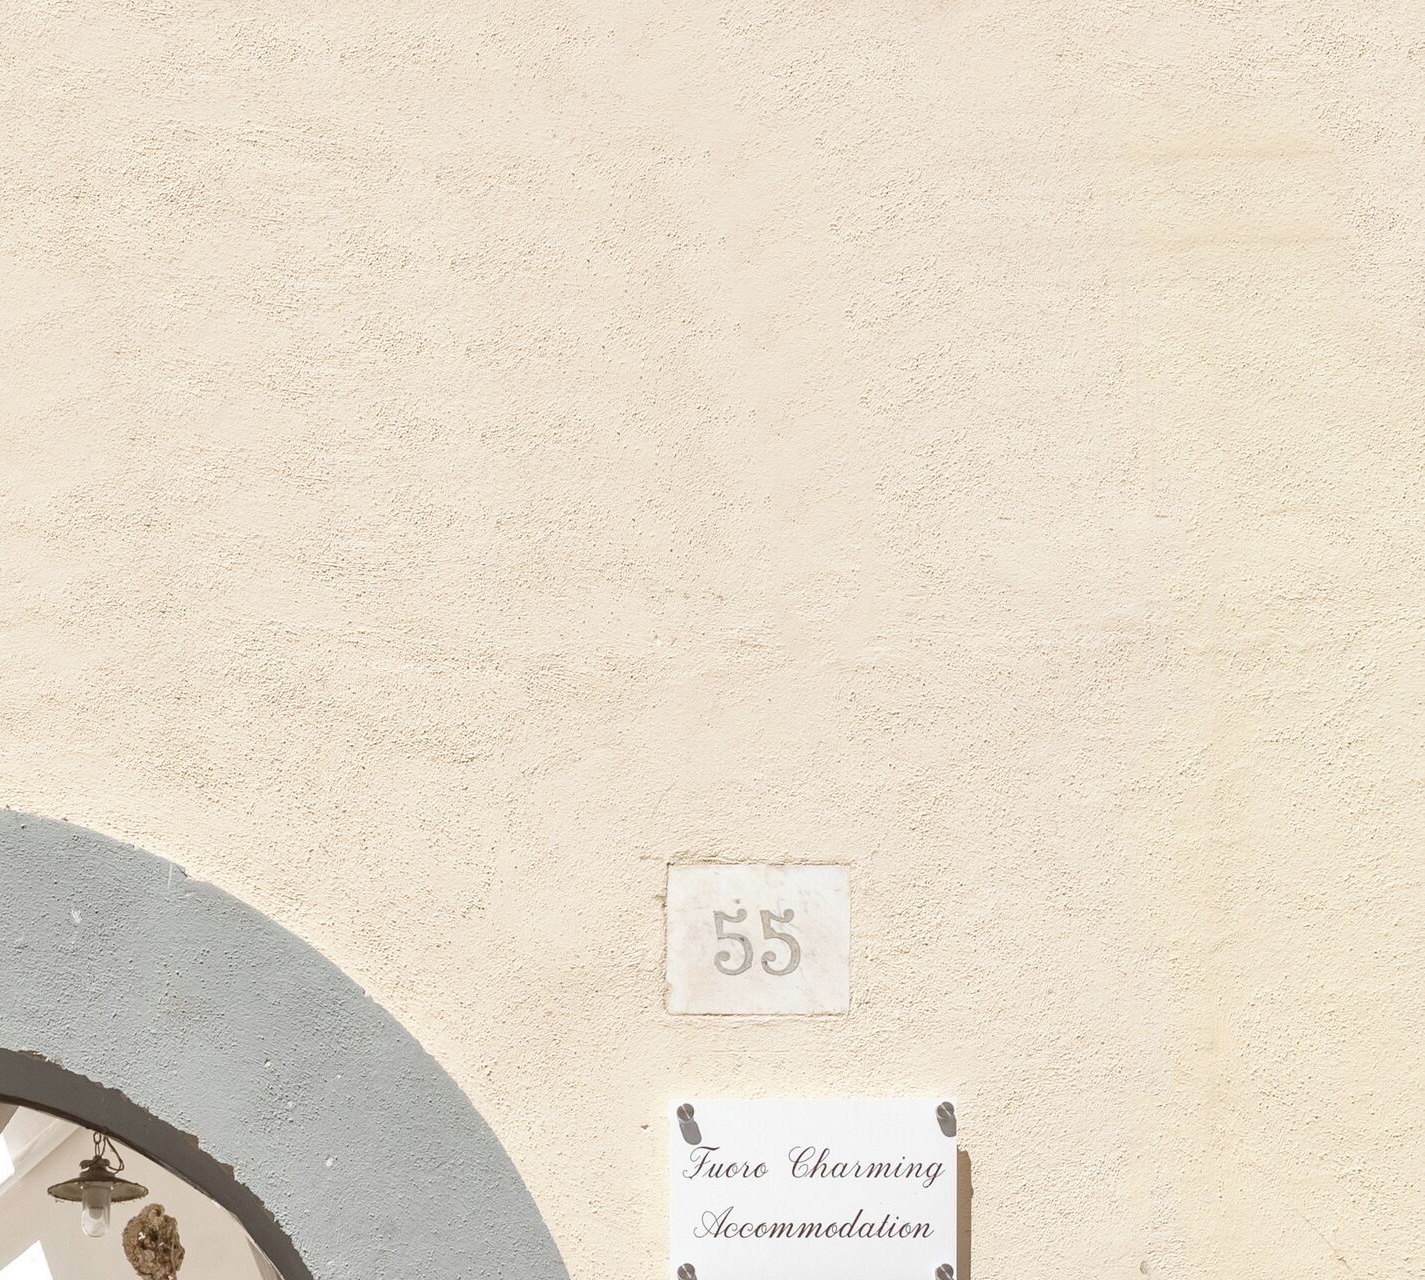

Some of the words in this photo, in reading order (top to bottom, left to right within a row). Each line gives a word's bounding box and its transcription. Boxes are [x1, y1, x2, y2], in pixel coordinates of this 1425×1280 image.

[712, 907, 801, 976] 55
[682, 1145, 770, 1180] Fuoro
[787, 1145, 946, 1189] Charming
[693, 1205, 935, 1239] Accommodation
